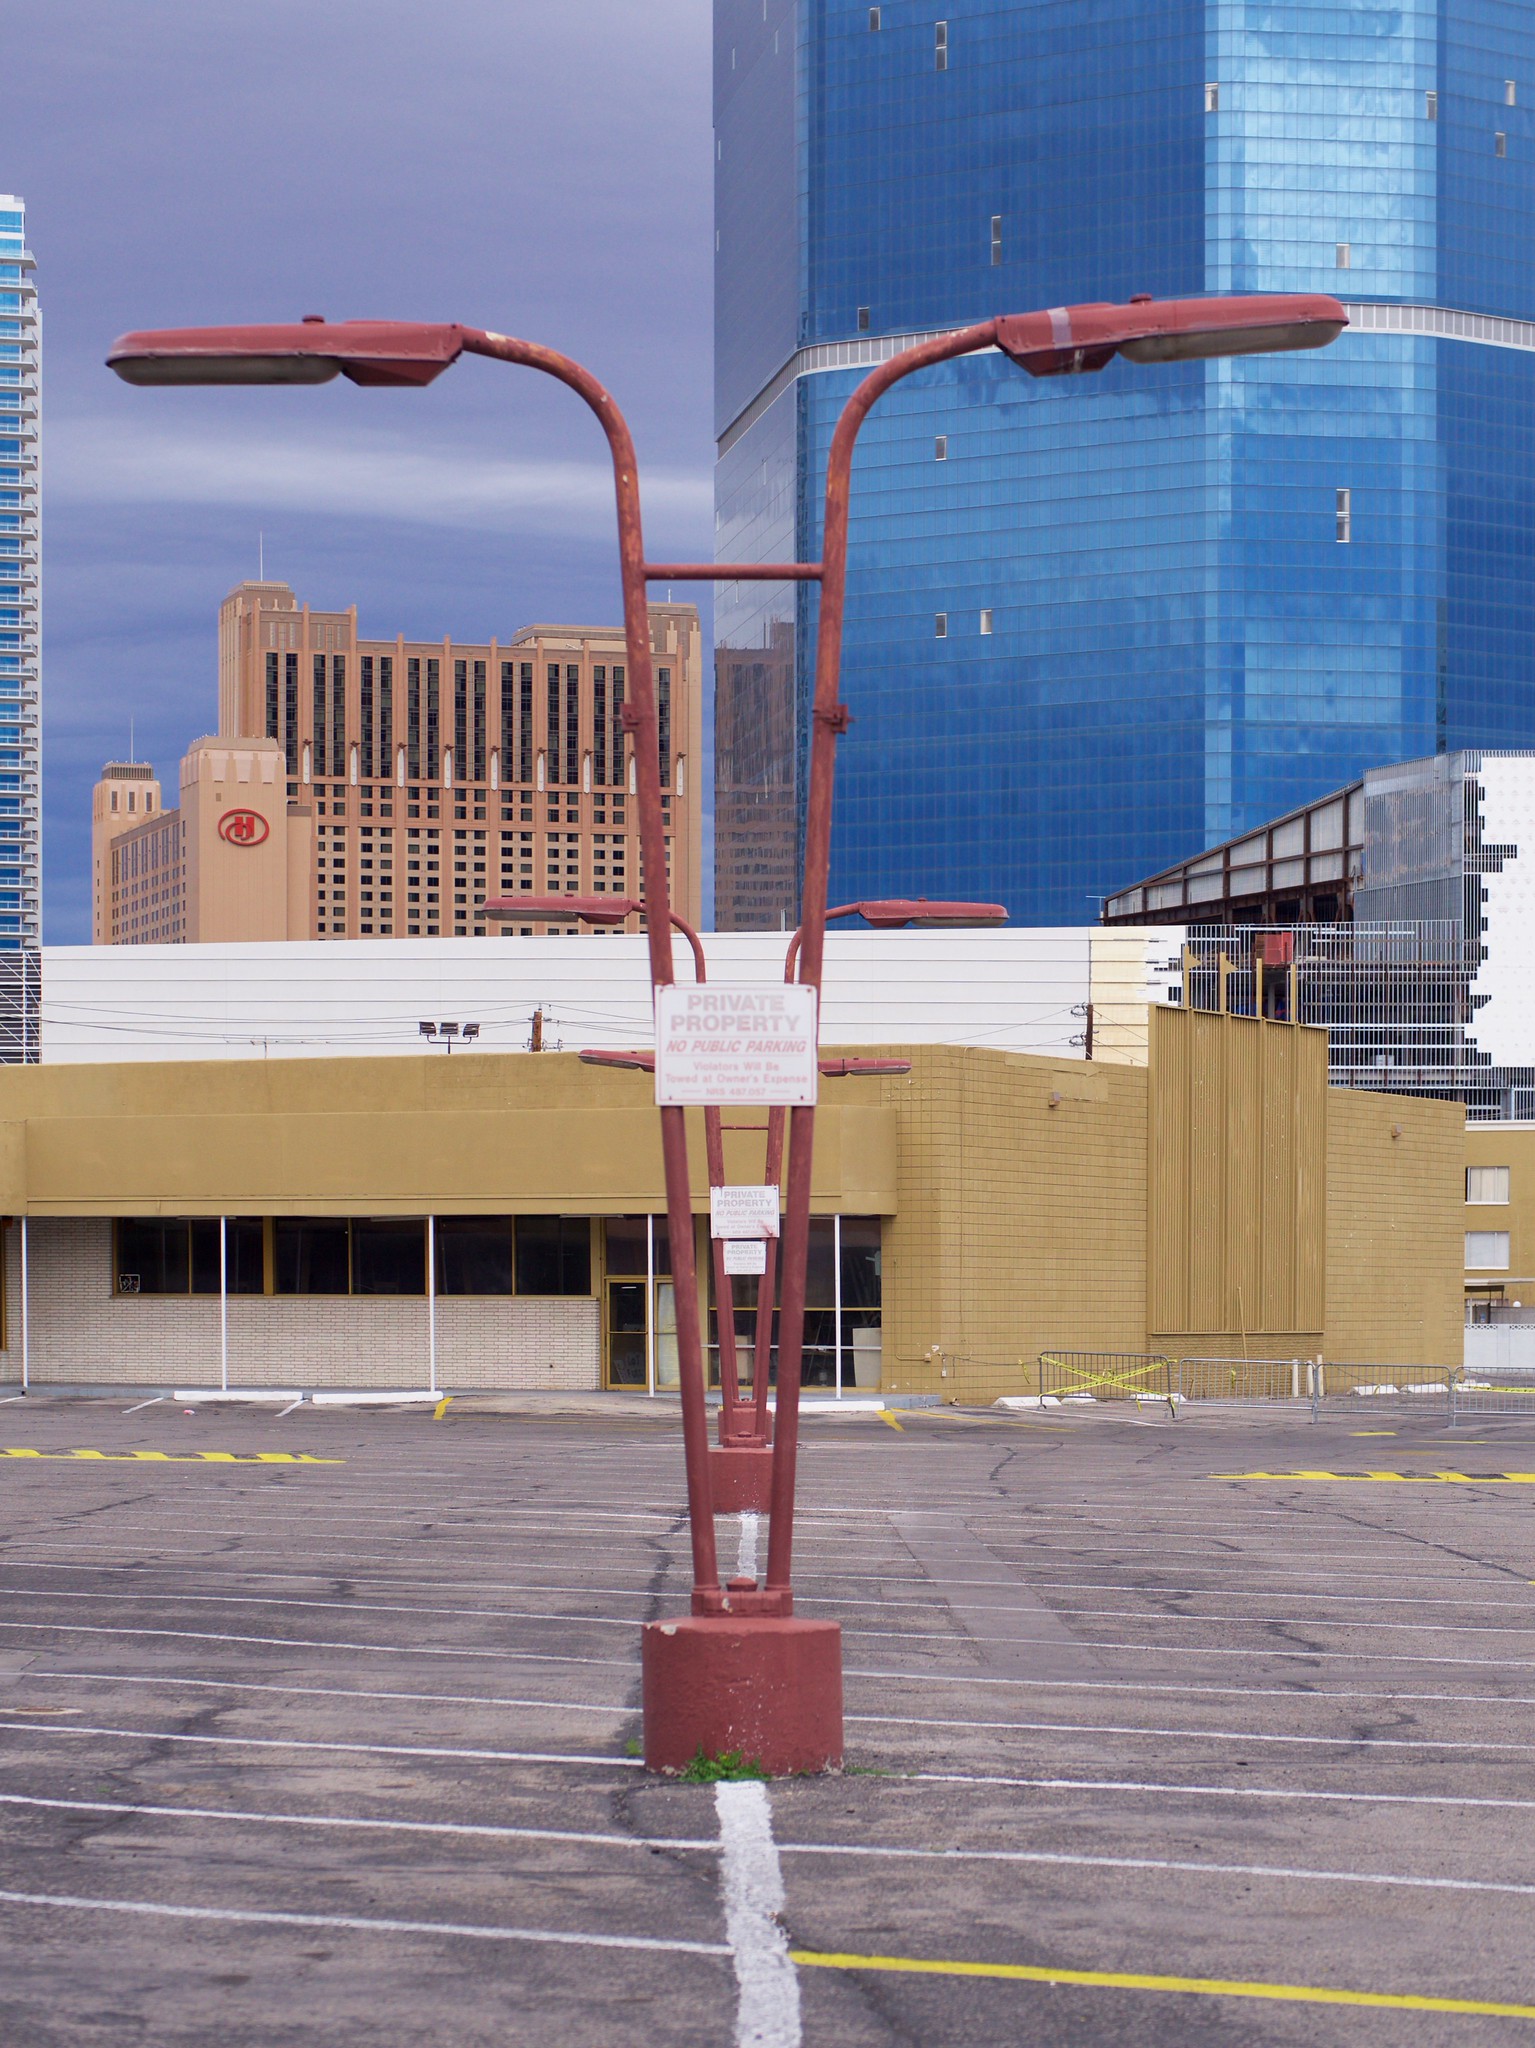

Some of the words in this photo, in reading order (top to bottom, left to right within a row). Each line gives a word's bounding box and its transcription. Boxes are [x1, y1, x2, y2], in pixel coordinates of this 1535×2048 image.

[687, 994, 785, 1012] PRIVATE
[670, 1015, 800, 1032] PROPERTY
[665, 1040, 687, 1053] NO
[691, 1040, 742, 1053] PUBLIC
[745, 1040, 807, 1053] PARKING
[693, 1061, 739, 1071] Violators
[743, 1061, 762, 1071] Will
[765, 1061, 780, 1071] Be
[665, 1074, 698, 1083] Towed
[702, 1074, 712, 1083] at
[716, 1074, 759, 1083] Owner's
[763, 1074, 808, 1085] Expense
[723, 1191, 766, 1199] PRIVATE
[716, 1199, 772, 1207] PROPERTY
